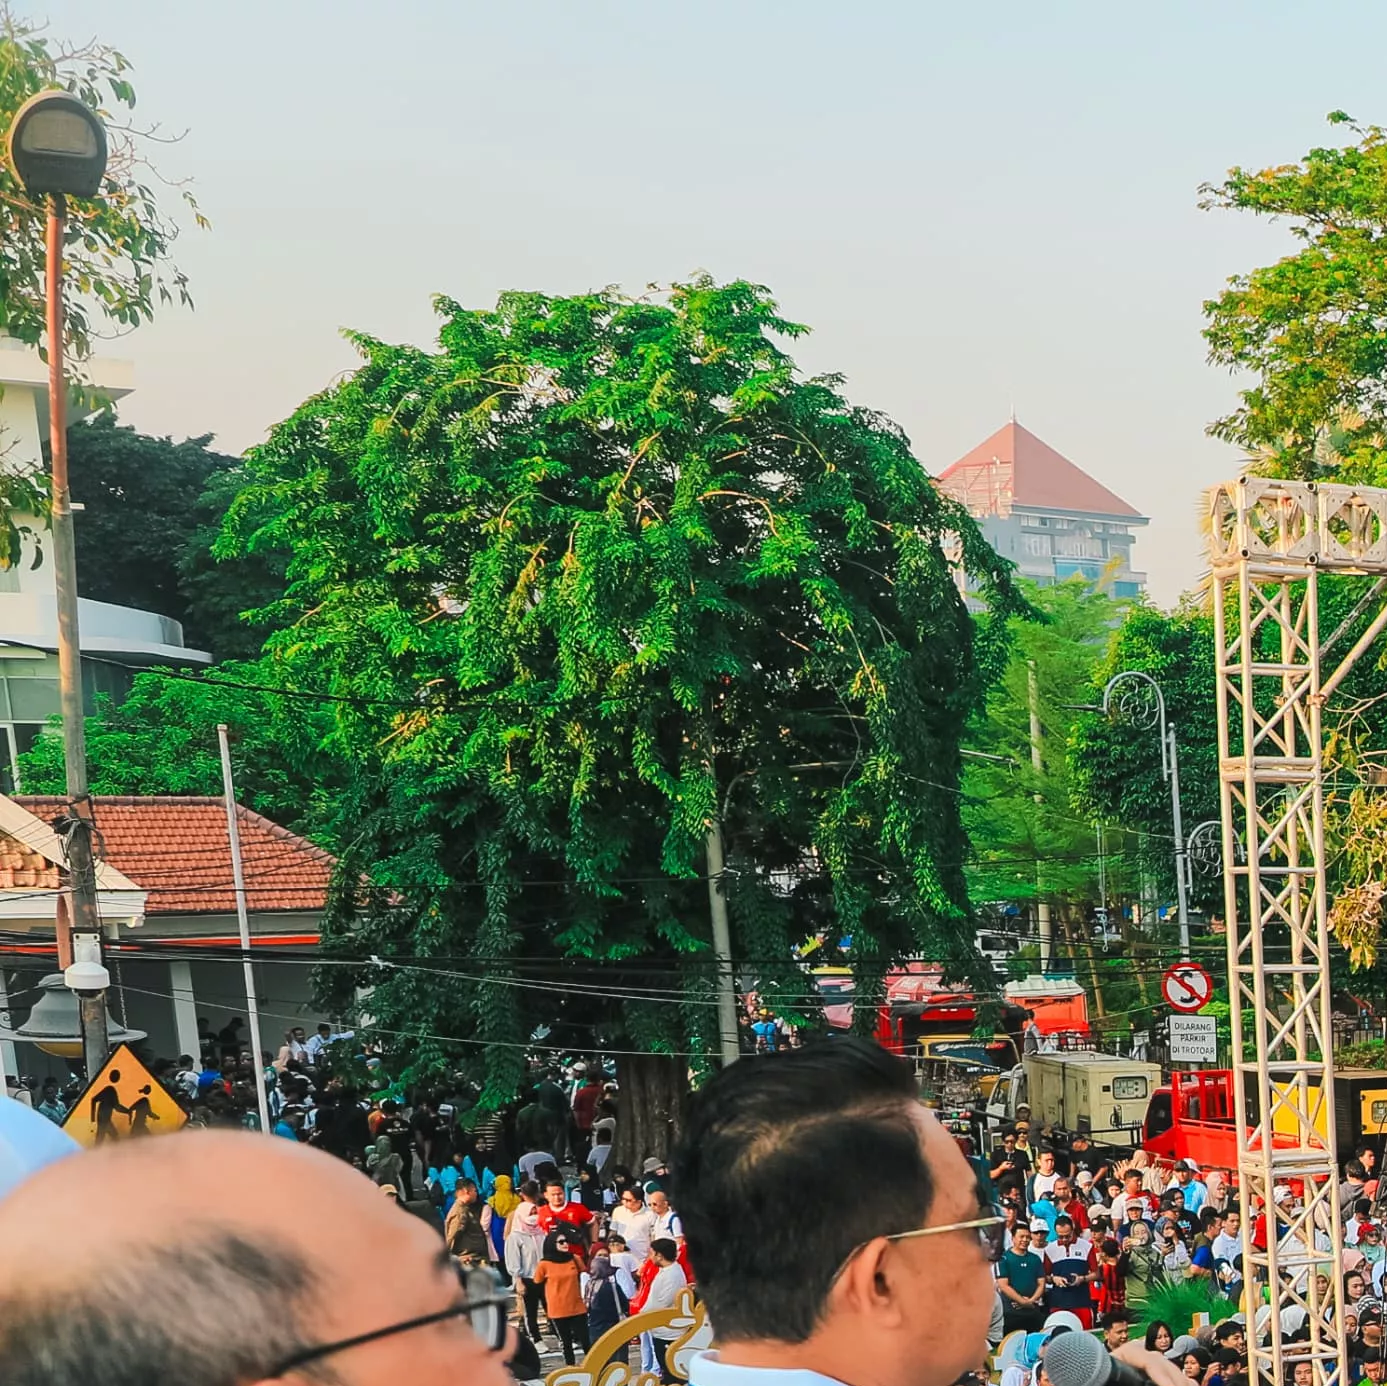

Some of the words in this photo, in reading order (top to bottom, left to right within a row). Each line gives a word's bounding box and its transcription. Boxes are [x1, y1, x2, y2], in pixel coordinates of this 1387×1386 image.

[1174, 1022, 1212, 1031] DILARANG
[1180, 1033, 1206, 1042] PARKIR
[1172, 1046, 1180, 1054] DI
[1182, 1046, 1215, 1055] TROTOAR
